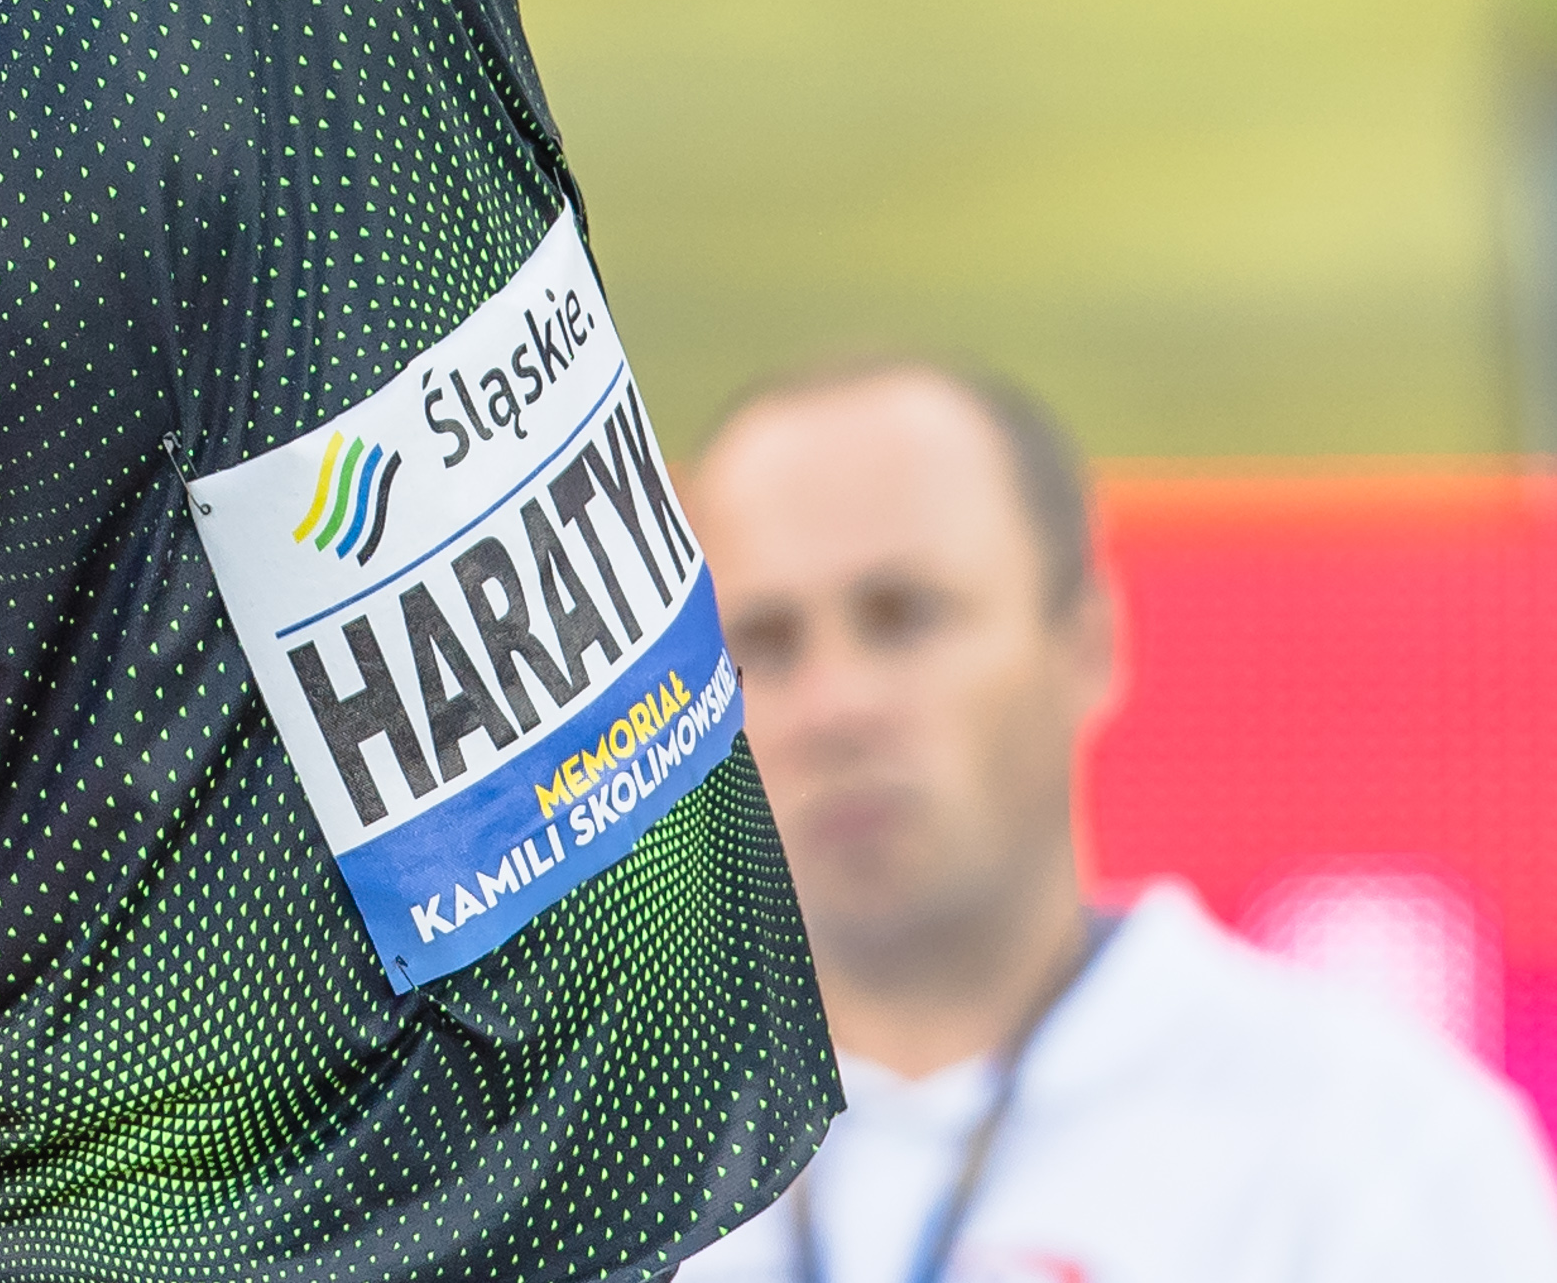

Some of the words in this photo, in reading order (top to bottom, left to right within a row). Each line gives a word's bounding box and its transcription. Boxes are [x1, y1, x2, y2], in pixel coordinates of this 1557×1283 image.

[422, 288, 595, 469] Śląskie.
[287, 379, 695, 828] HARATYK
[535, 670, 691, 819] MEMORIAŁ
[410, 824, 566, 943] KAMILI
